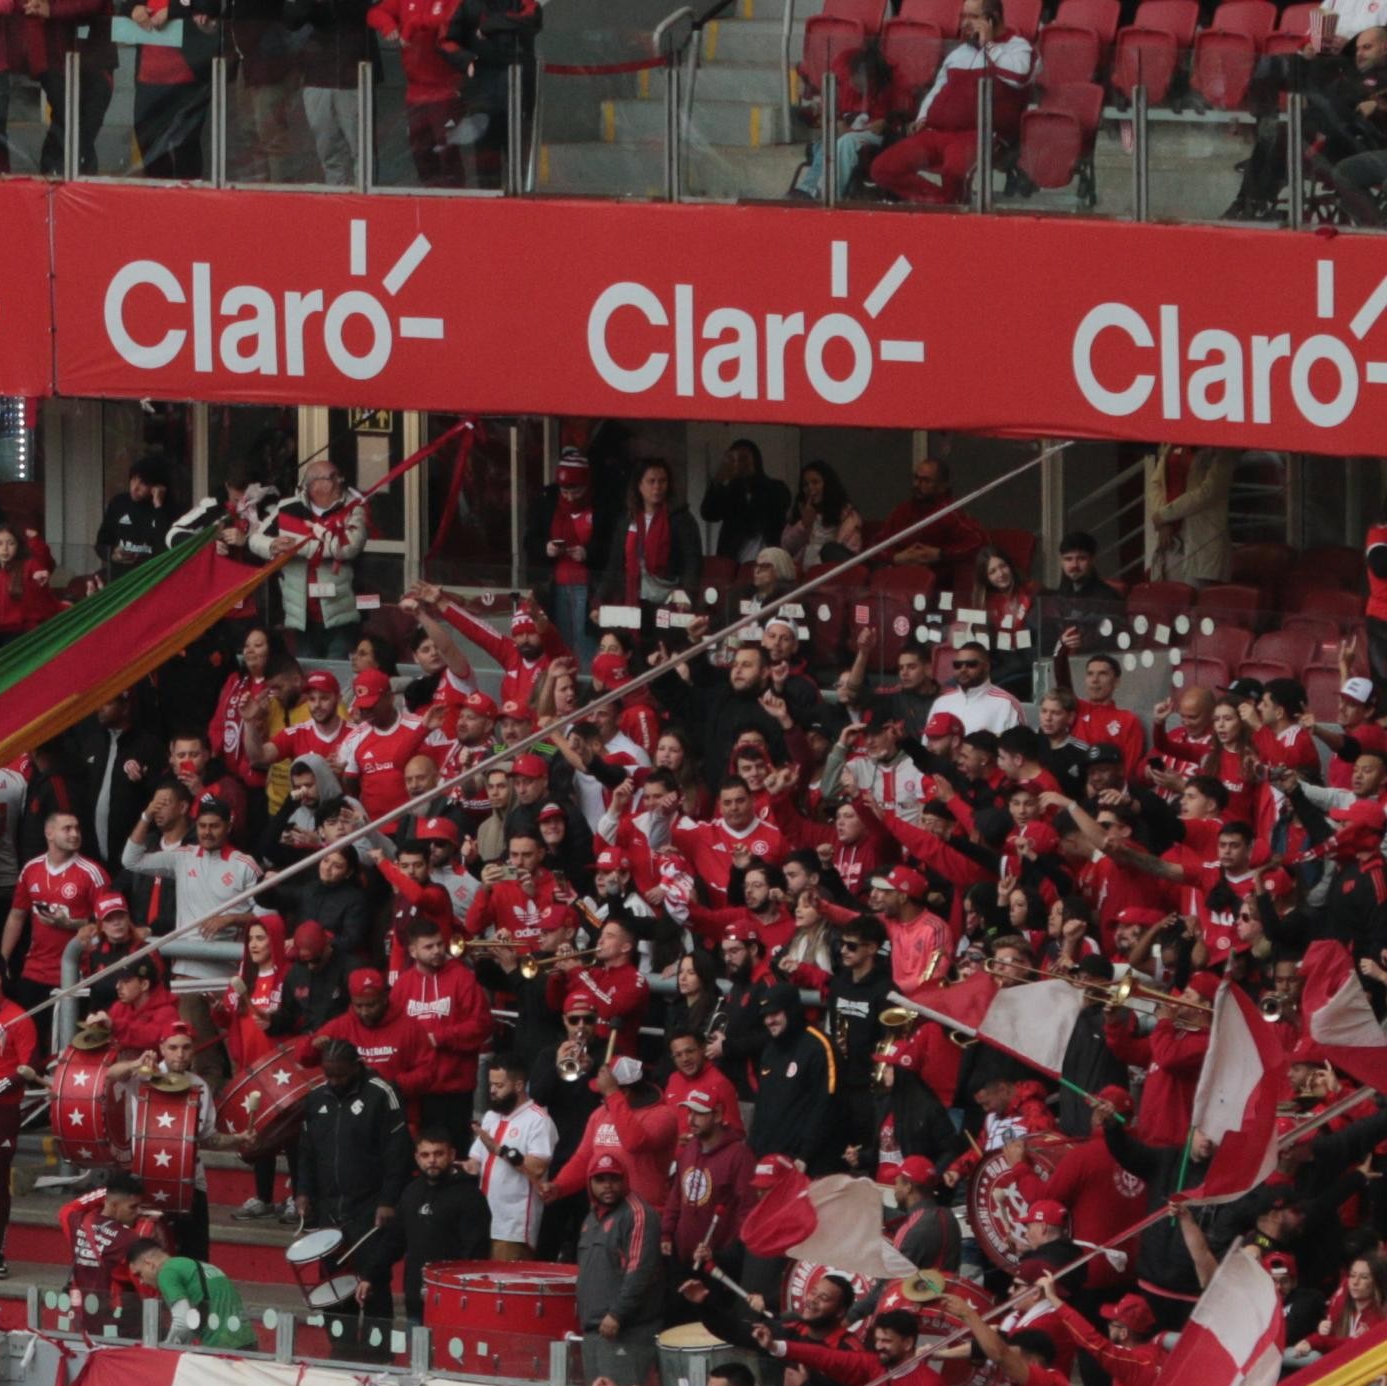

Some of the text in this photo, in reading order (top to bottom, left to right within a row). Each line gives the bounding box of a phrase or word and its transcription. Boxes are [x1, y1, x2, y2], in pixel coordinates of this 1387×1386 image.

[103, 257, 393, 381] Claro
[586, 279, 874, 405] Claro
[1071, 299, 1358, 429] Claro
